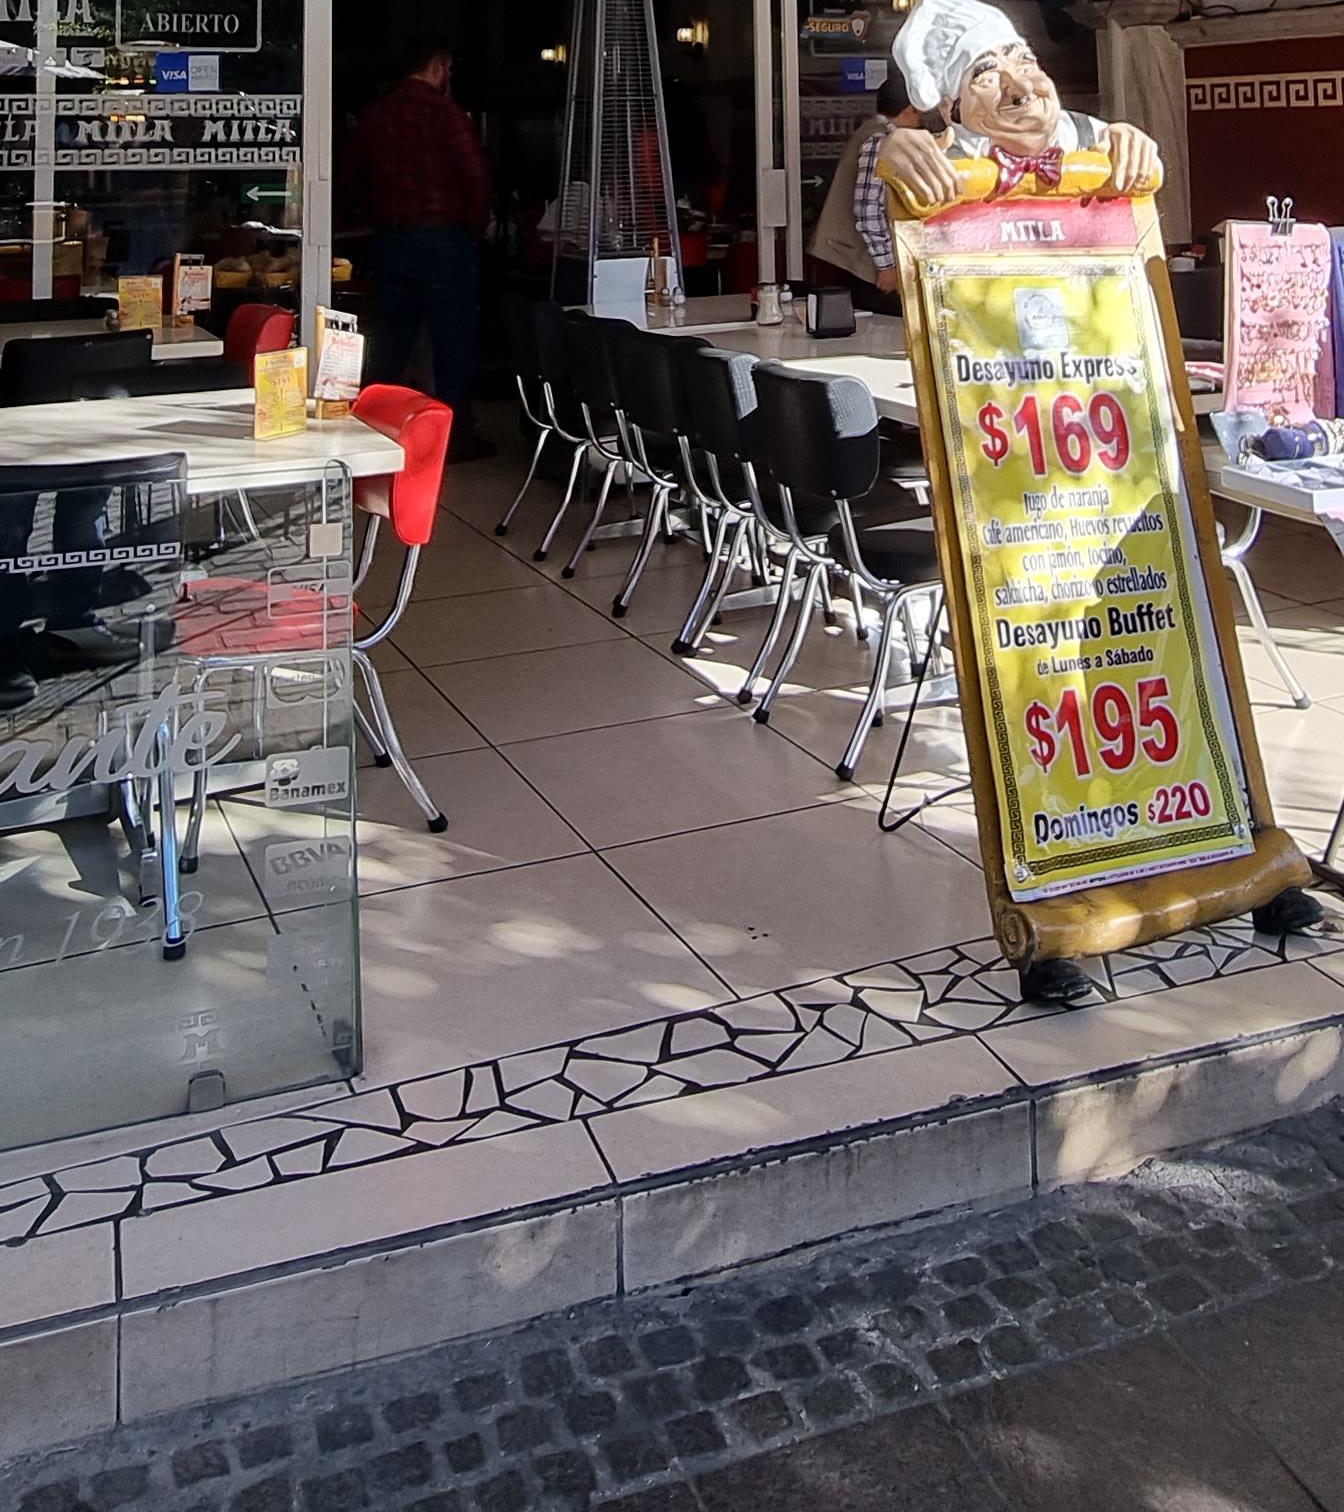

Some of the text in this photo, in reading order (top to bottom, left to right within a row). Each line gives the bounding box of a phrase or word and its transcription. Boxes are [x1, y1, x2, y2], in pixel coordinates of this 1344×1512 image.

[140, 13, 240, 34] ABIERTO
[808, 22, 849, 33] SEGURO
[162, 70, 187, 81] VISA
[202, 118, 294, 143] MITLA
[1000, 219, 1066, 243] MITLA
[956, 351, 1138, 386] Desayuno Express
[978, 391, 1130, 476] $169
[1023, 484, 1110, 519] Jugo de naranja
[983, 519, 1003, 545] Café
[1071, 515, 1110, 539] Huevos
[1022, 554, 1045, 571] con
[1052, 574, 1092, 600] chorizo
[1095, 580, 1104, 596] o
[1106, 565, 1168, 594] estrellados
[996, 602, 1176, 650] Desayuno Buffet
[1037, 644, 1155, 676] de Lunes a Sábado
[1025, 677, 1180, 777] $195
[269, 778, 346, 802] Banamex
[1034, 782, 1212, 844] Domingos $220
[269, 841, 348, 876] BBVA
[52, 889, 204, 963] 1938
